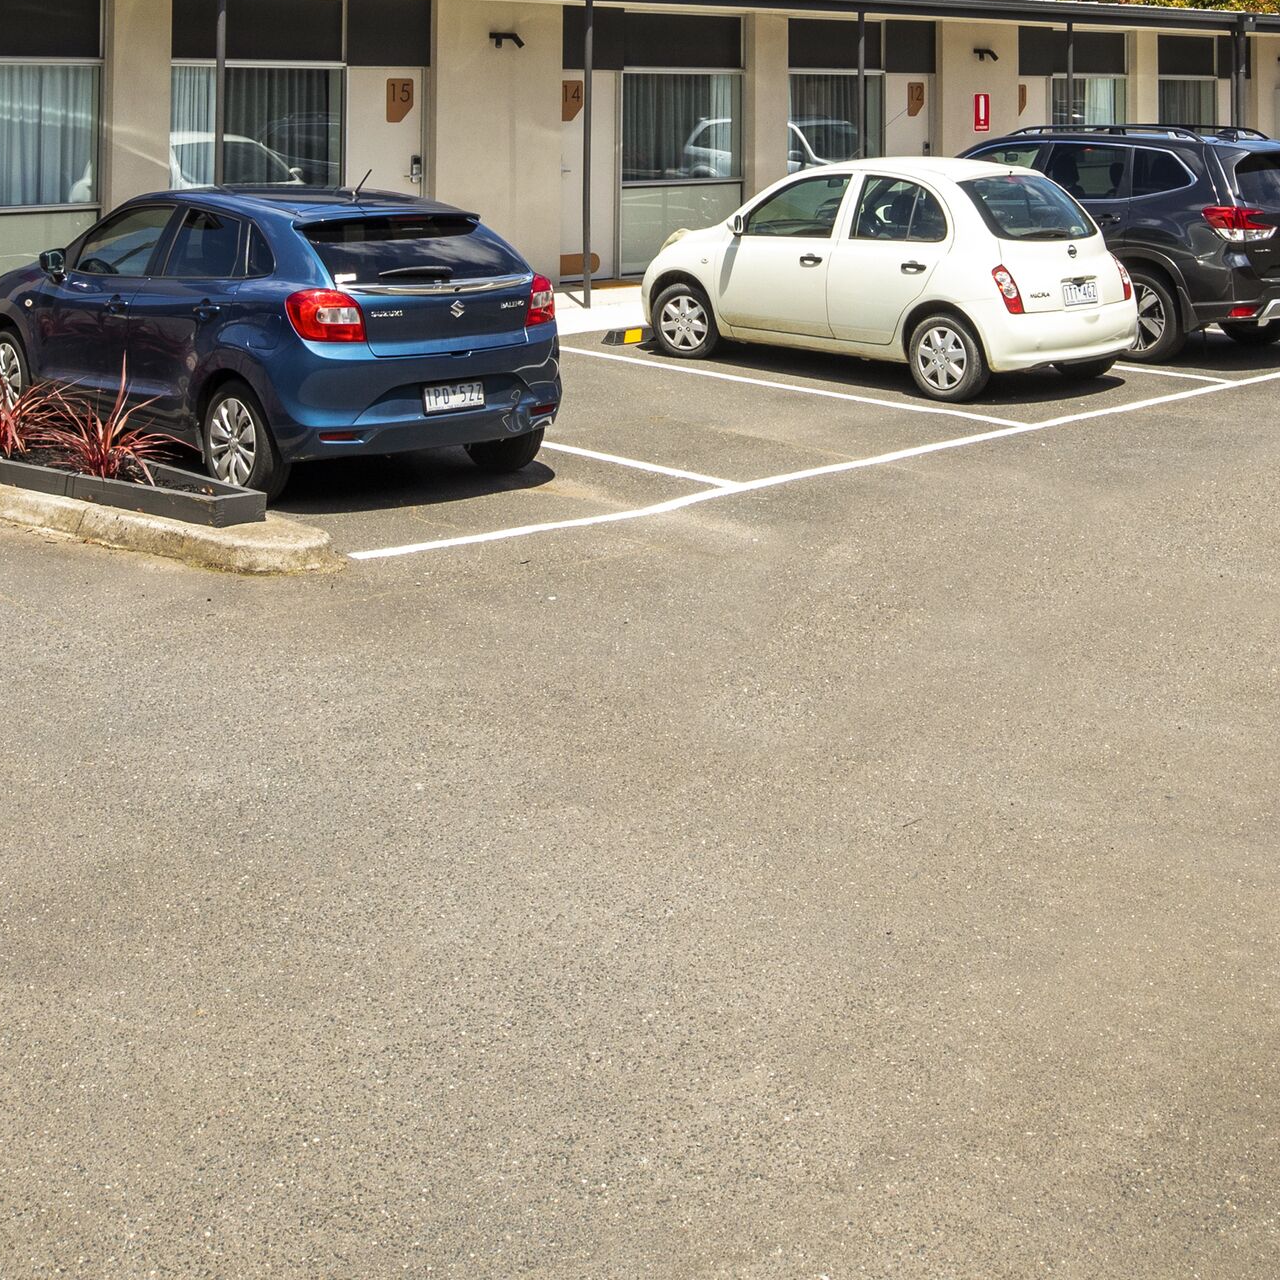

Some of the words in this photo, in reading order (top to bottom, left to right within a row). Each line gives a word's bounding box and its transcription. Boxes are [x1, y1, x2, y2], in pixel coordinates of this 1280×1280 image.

[391, 83, 410, 103] 15
[563, 84, 580, 102] 14
[910, 85, 923, 102] 12
[370, 310, 403, 318] SUZUKI
